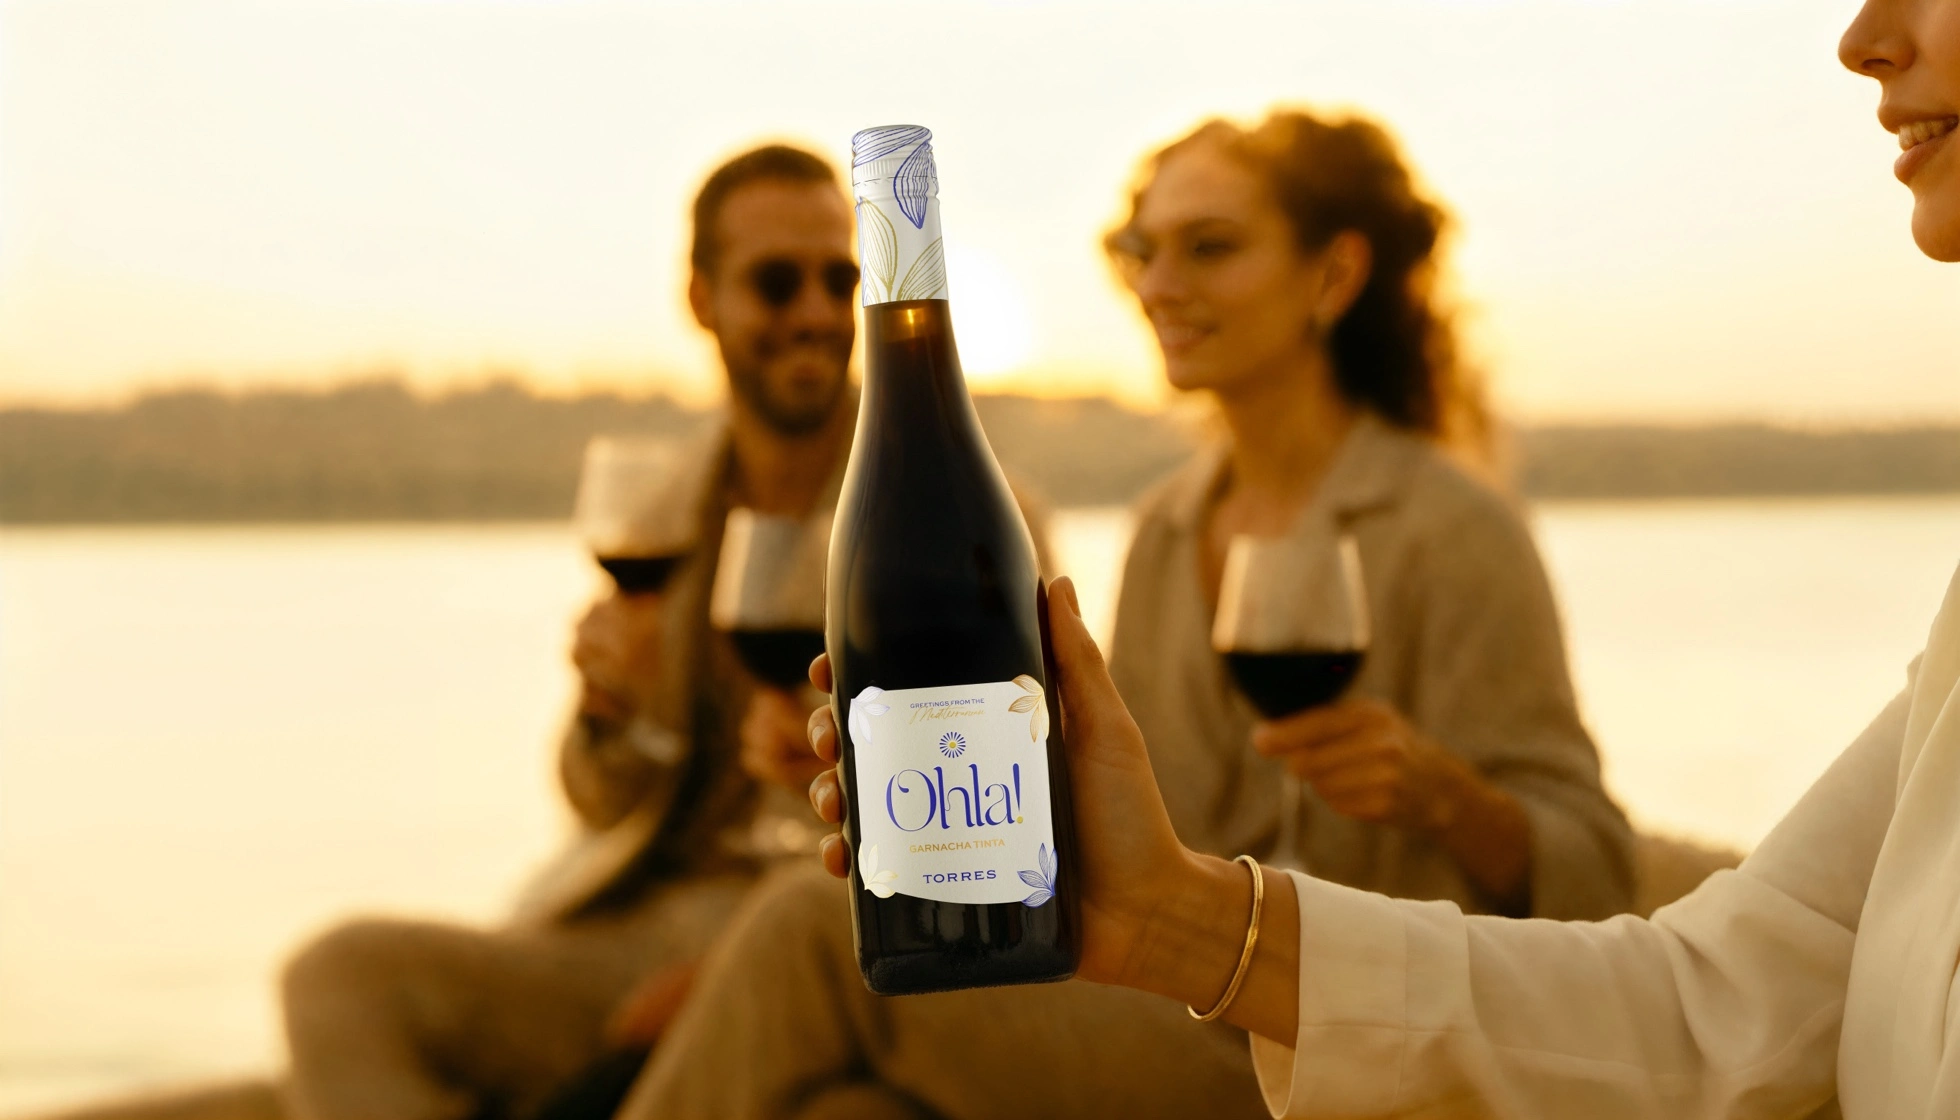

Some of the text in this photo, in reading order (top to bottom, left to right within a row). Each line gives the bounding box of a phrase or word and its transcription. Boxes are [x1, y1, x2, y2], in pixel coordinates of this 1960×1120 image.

[910, 701, 949, 709] GREETINGS
[886, 763, 1023, 832] Ohla!
[909, 839, 1005, 853] GARNACHA TINTA
[923, 869, 997, 884] TORRES
